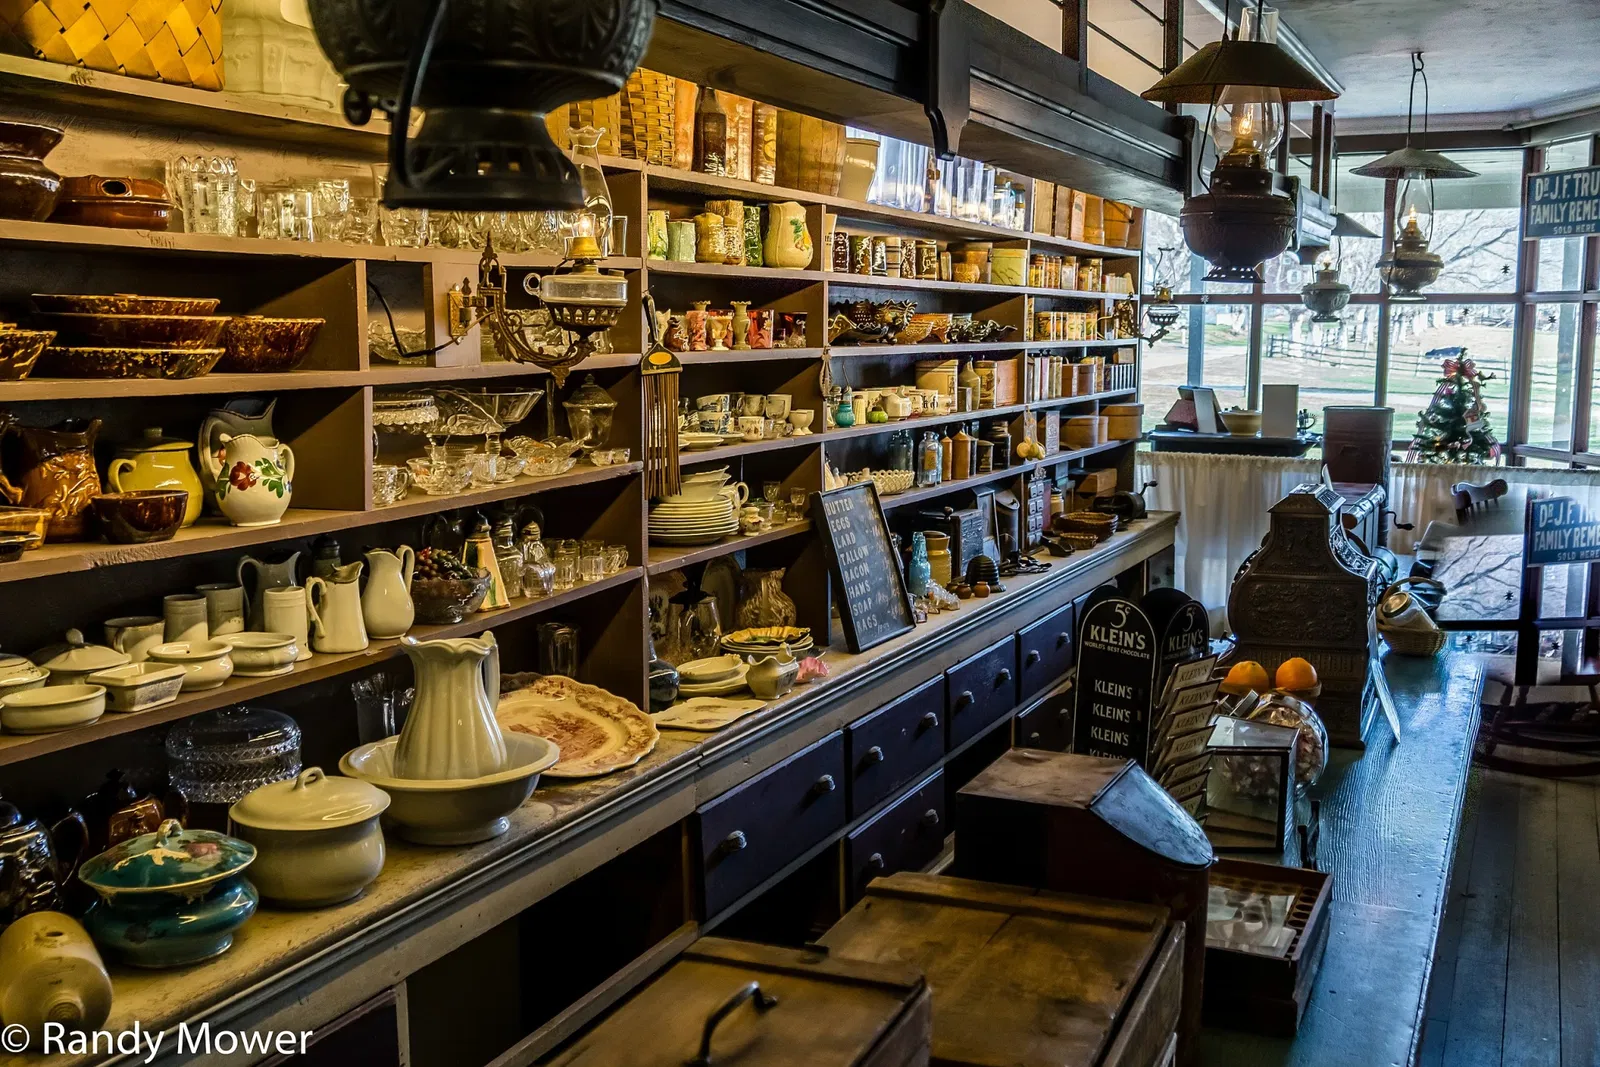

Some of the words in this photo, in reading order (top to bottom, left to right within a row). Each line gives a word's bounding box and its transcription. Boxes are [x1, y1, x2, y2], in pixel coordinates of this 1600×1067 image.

[1531, 202, 1567, 224] FAMILY
[1553, 225, 1572, 235] SOLD
[1576, 223, 1596, 233] HERE
[825, 498, 854, 515] BUTTER
[830, 516, 851, 533] EGGS
[835, 532, 857, 549] LARD
[1535, 529, 1572, 551] FAMILY
[840, 545, 870, 566] TALLOW
[1557, 552, 1576, 561] SOLD
[844, 562, 870, 583] BACON
[848, 580, 872, 599] HAMS
[852, 598, 873, 616] SOAP
[856, 614, 878, 633] RAGS
[1090, 624, 1146, 650] KLEIN'S
[1168, 629, 1204, 652] KLEIN'S
[1107, 645, 1119, 653] BEST
[1120, 648, 1150, 659] CHOCOLATE
[1094, 679, 1133, 699] KLEIN'S
[1092, 703, 1131, 723] KLEIN'S
[1090, 726, 1129, 746] KLEIN'S
